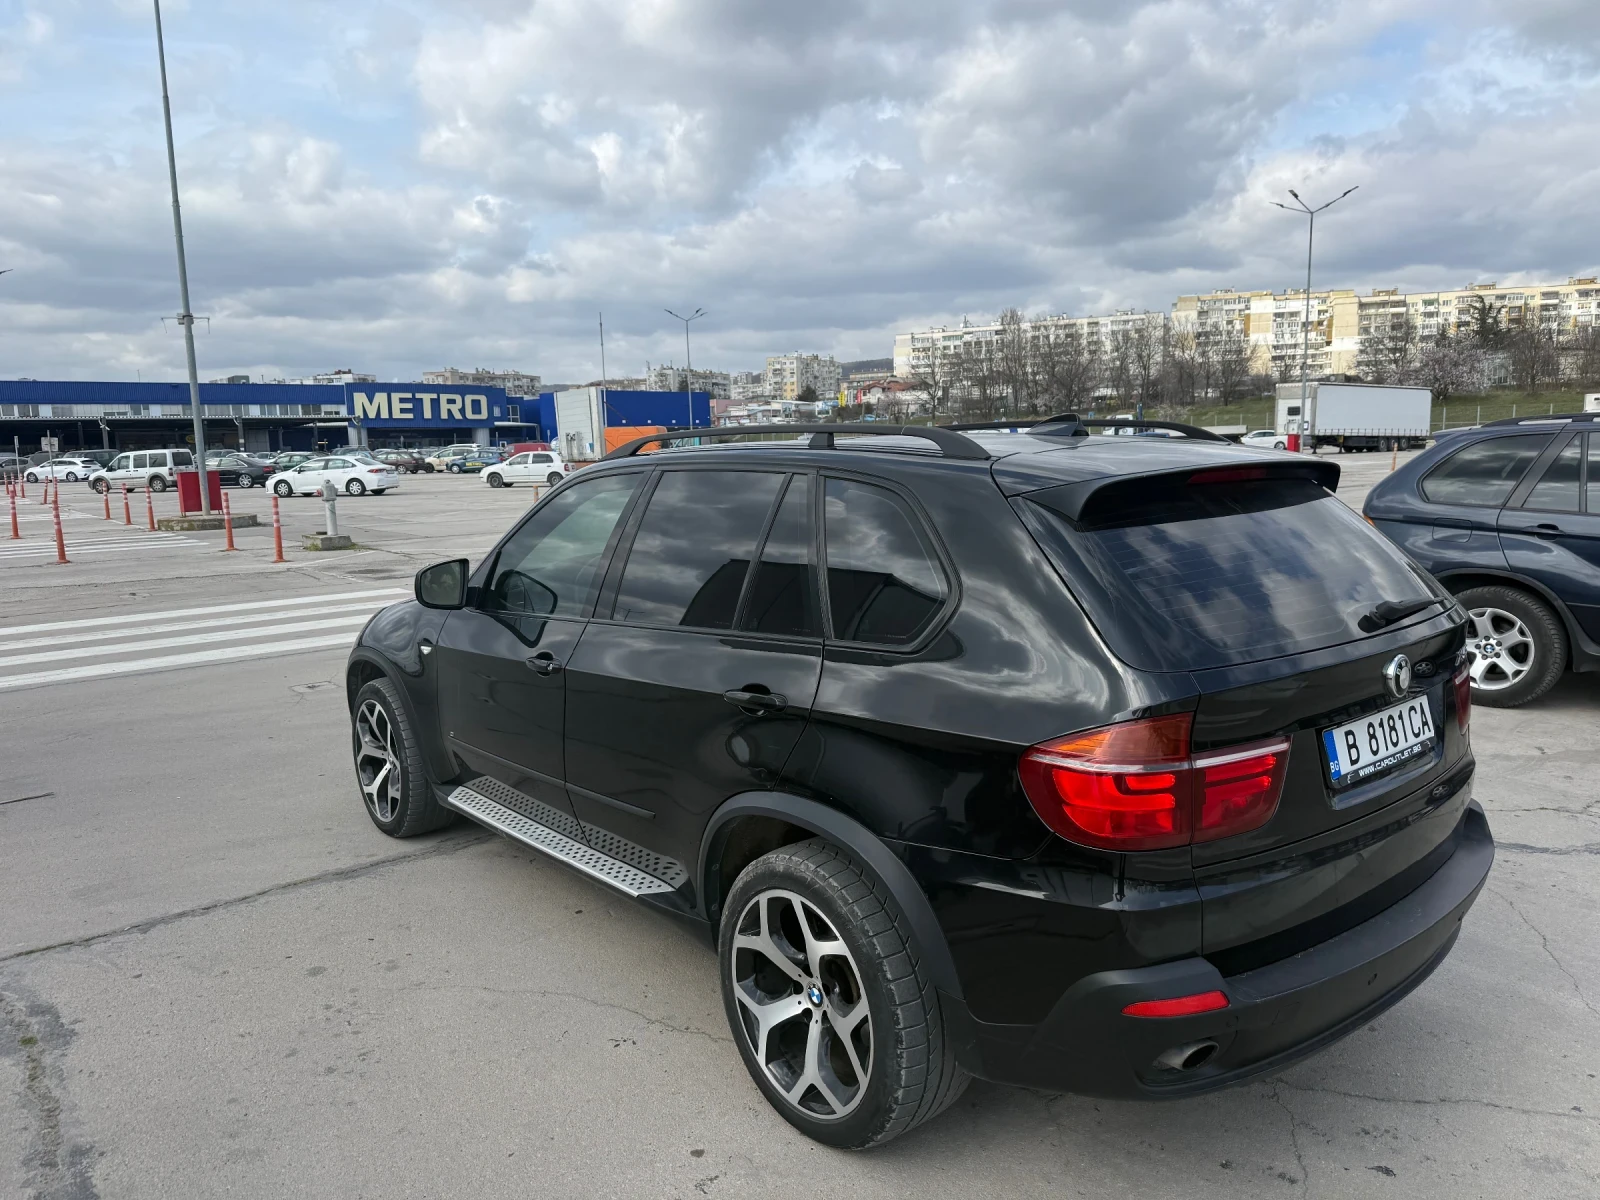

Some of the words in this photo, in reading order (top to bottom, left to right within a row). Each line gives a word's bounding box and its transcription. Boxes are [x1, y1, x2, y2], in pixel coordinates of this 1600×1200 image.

[353, 392, 488, 420] METRO
[1344, 729, 1361, 767] B
[1330, 761, 1340, 773] BG
